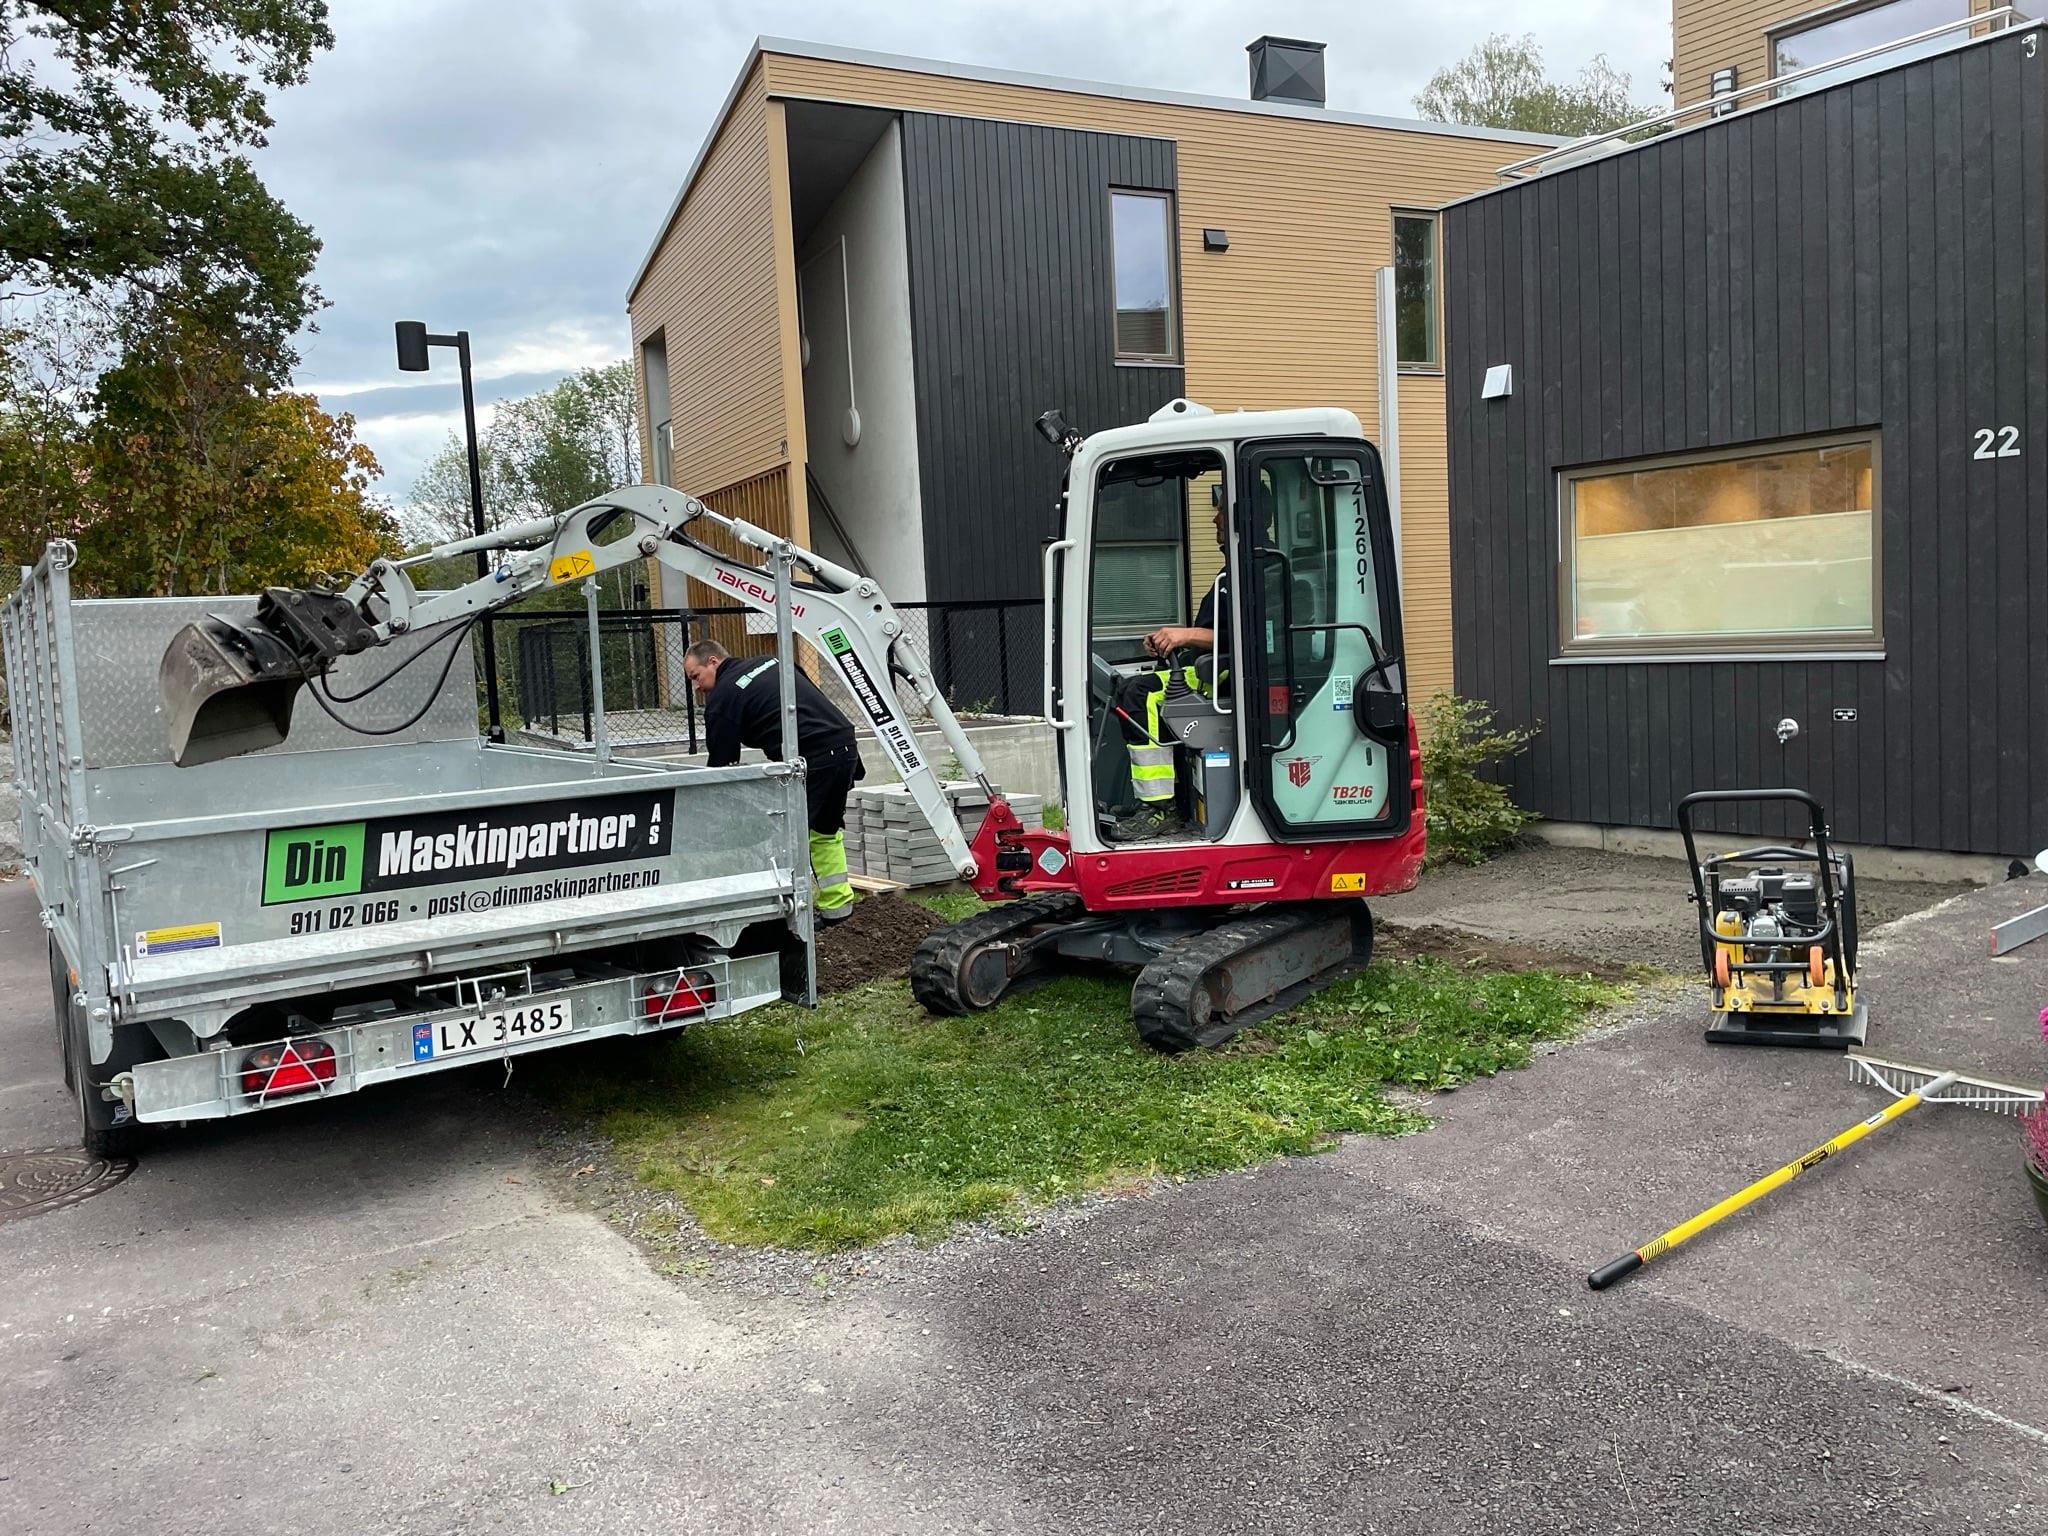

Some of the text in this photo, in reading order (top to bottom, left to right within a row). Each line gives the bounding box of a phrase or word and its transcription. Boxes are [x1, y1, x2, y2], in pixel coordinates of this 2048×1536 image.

[1974, 425, 2021, 461] 22
[714, 567, 805, 618] TAKEUHI
[828, 633, 844, 650] Din
[839, 652, 884, 714] Maskinpartner
[887, 725, 904, 741] 911
[896, 739, 911, 753] 02
[903, 751, 921, 769] 066
[1332, 785, 1374, 799] TB216
[284, 839, 347, 888] Din
[378, 812, 636, 877] Maskinpartner
[290, 868, 661, 935] 911 02 066 post@dinmaskinpartner.no
[440, 1003, 563, 1051] LX 3485
